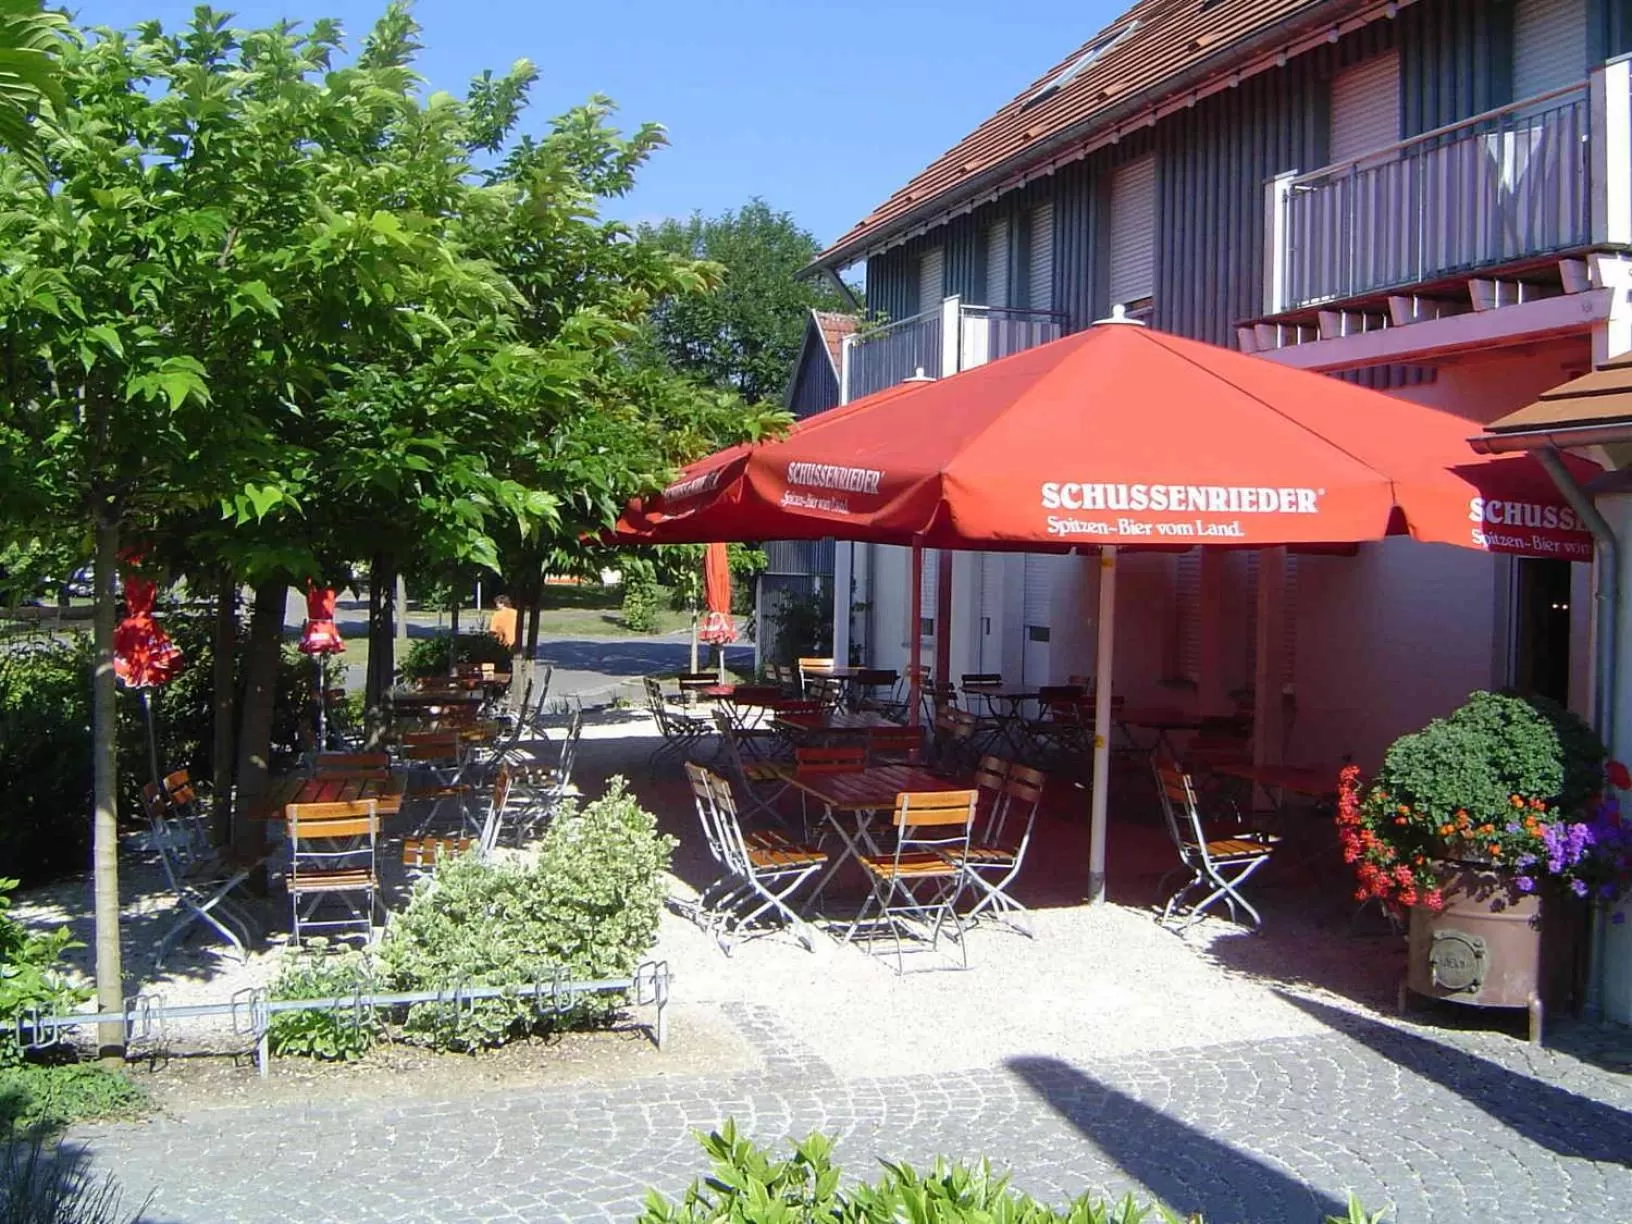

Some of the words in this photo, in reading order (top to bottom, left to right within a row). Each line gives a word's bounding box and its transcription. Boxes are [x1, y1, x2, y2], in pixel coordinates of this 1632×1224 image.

[787, 461, 880, 494] SCHUSSENRIEDER
[1041, 482, 1319, 513] SCHUSSENRIEDER
[1046, 516, 1152, 536] Spitzen-Bier
[1158, 524, 1194, 535] vom
[1197, 520, 1245, 537] Land.
[1471, 528, 1560, 555] Spitzen-Bier
